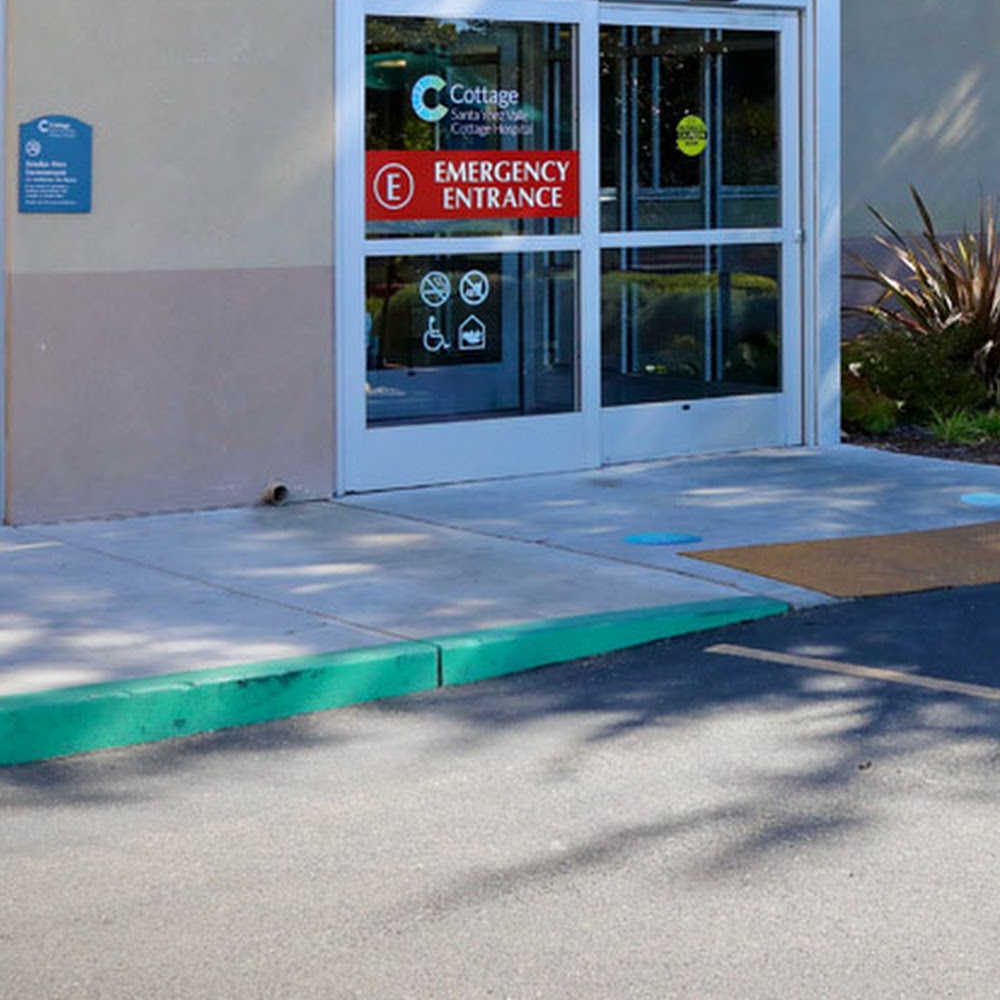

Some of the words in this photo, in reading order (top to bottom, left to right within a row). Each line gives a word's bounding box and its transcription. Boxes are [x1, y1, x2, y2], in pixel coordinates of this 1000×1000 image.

[450, 83, 519, 108] Cottage
[450, 107, 480, 121] Santa
[450, 120, 490, 137] Cottage
[434, 160, 570, 184] EMERGENCY
[386, 173, 401, 201] E
[442, 186, 563, 210] ENTRANCE
